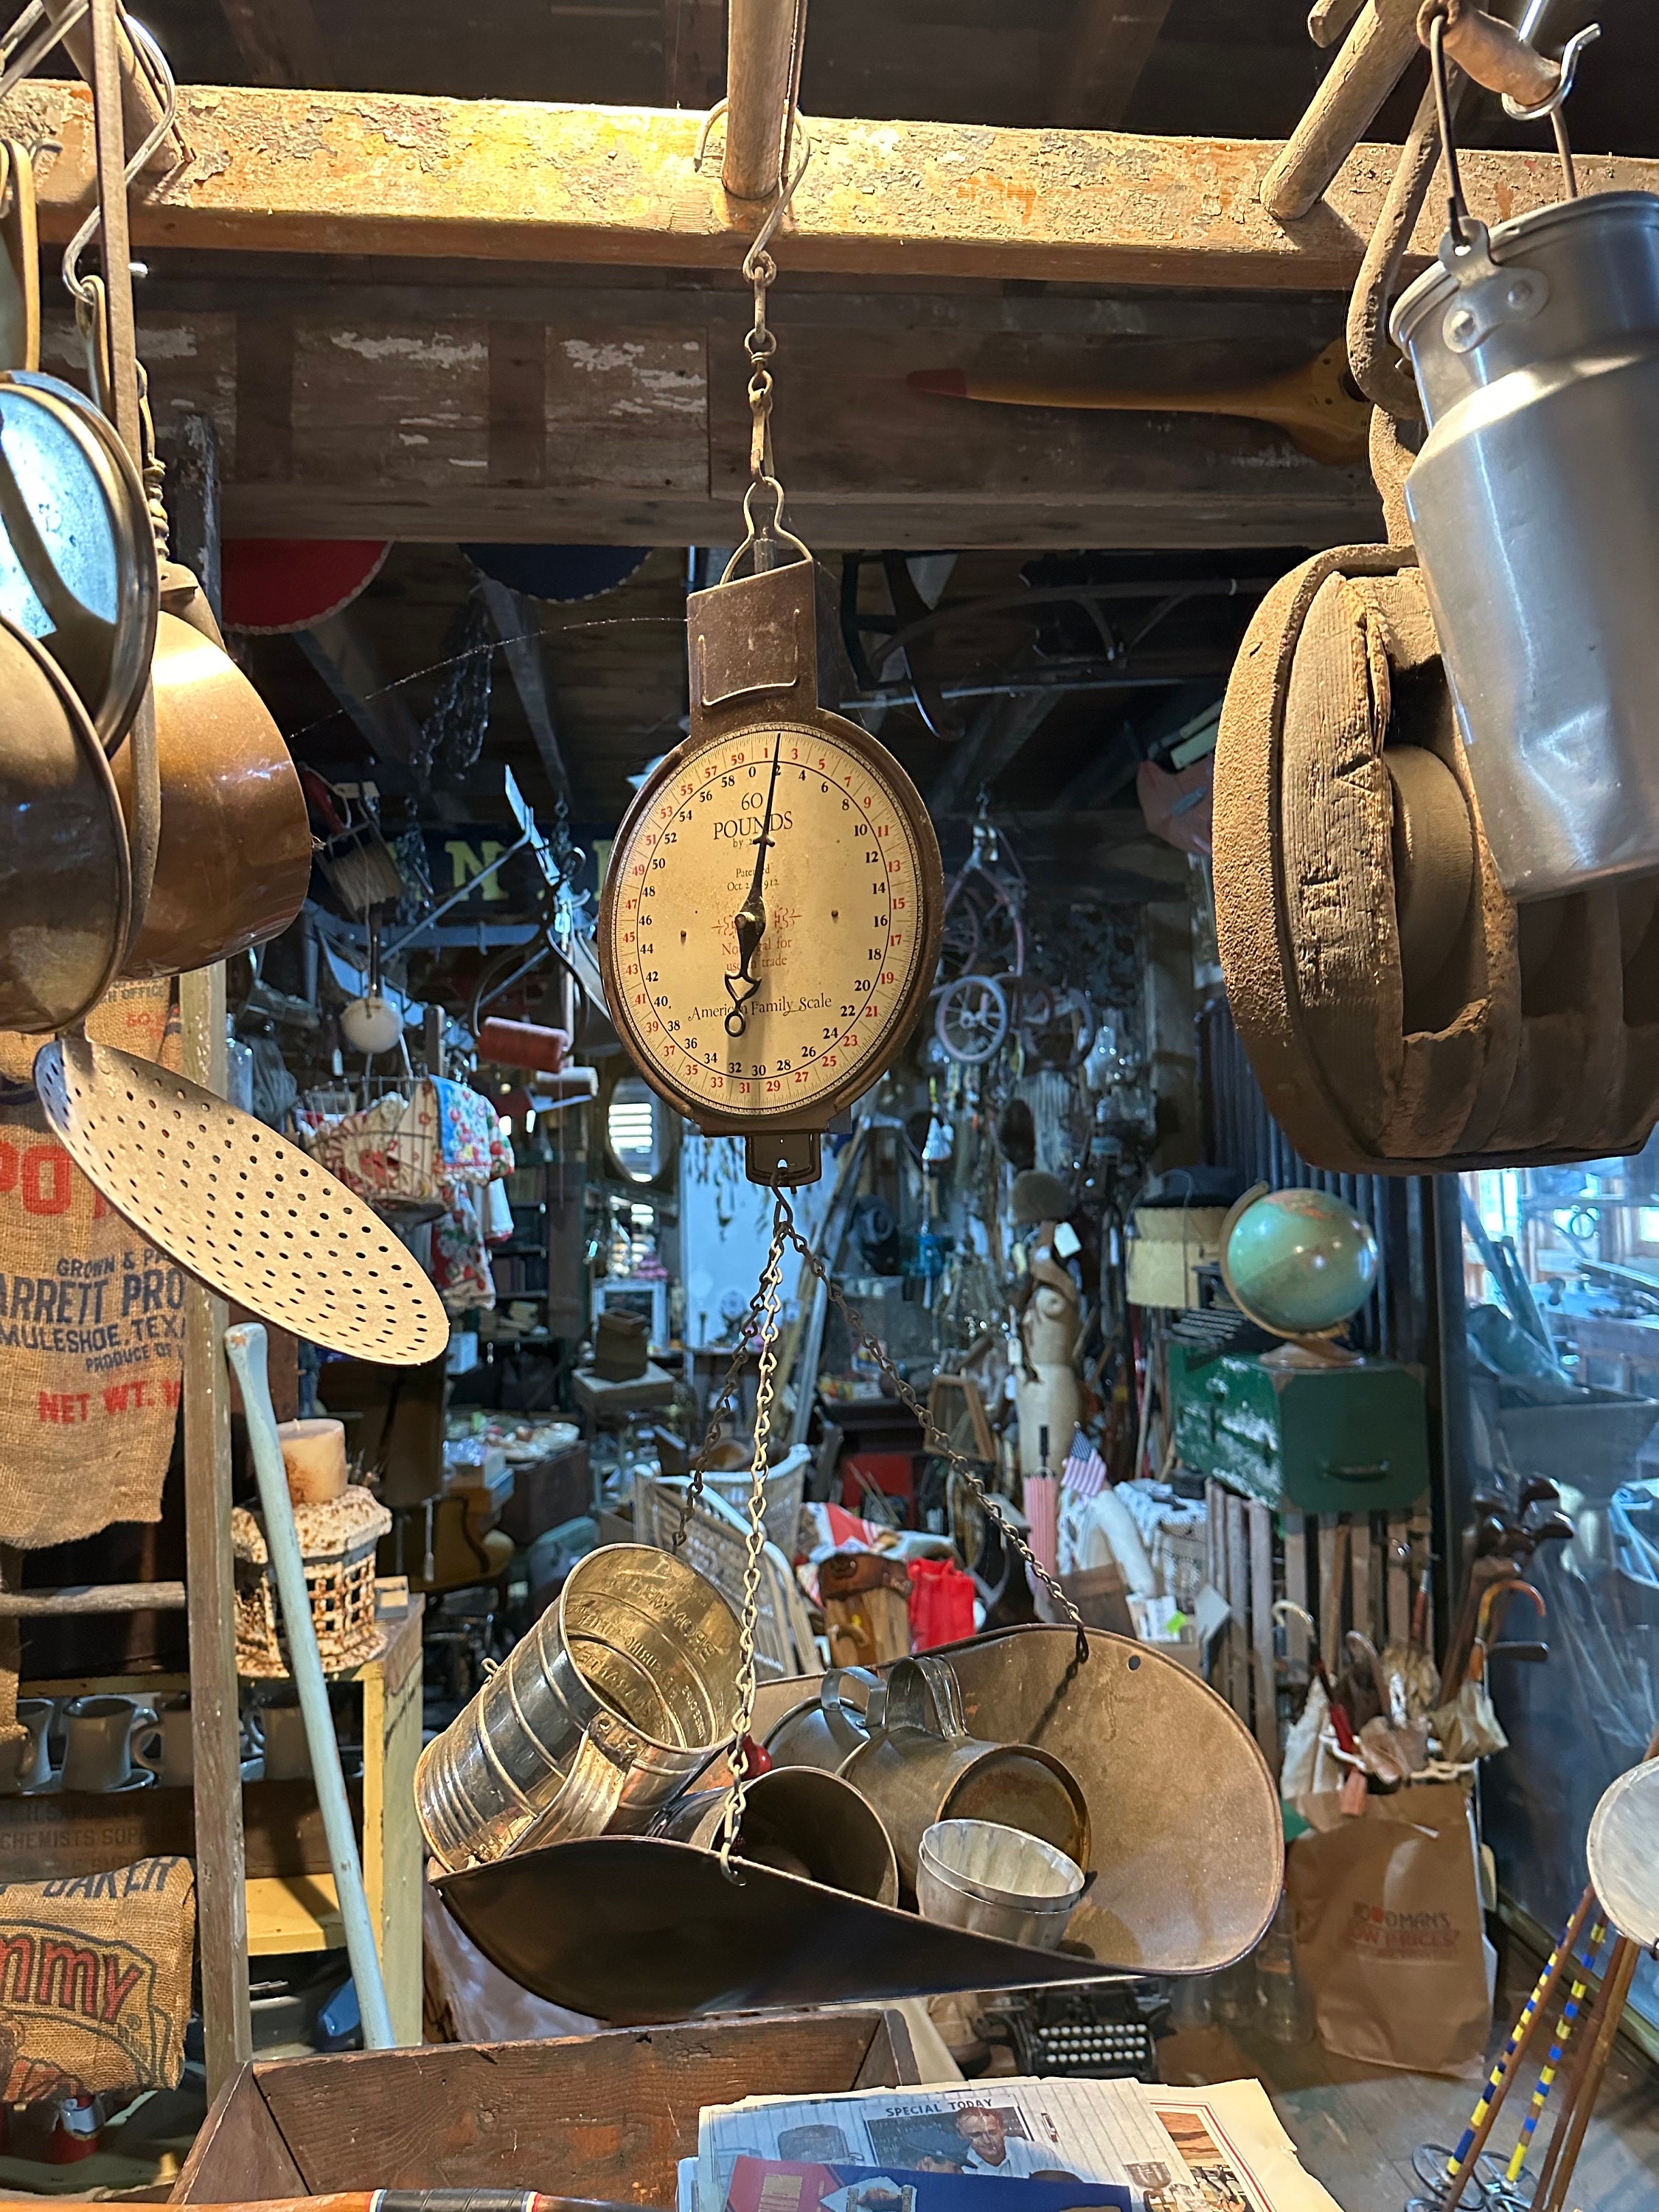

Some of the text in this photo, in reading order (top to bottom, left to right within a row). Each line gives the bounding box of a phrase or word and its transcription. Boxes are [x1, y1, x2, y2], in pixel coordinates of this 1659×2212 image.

[731, 752, 745, 765] 59
[764, 748, 768, 758] 1
[790, 748, 799, 759] 3
[818, 758, 826, 771] 5
[705, 765, 718, 779] 57
[748, 766, 757, 778] 0
[799, 770, 806, 782] 4
[721, 775, 735, 787] 58
[844, 776, 851, 787] 7
[680, 783, 693, 796] 55
[821, 782, 829, 793] 6
[700, 790, 712, 802] 56
[742, 792, 763, 810] 60
[863, 796, 872, 808] 9
[842, 799, 849, 811] 8
[661, 805, 672, 818] 53
[679, 810, 692, 822] 54
[714, 811, 793, 841] POUNDS
[854, 824, 868, 837] 10
[877, 824, 889, 838] 11
[646, 834, 656, 846] 51
[664, 832, 677, 844] 52
[866, 851, 879, 863] 12
[632, 864, 644, 876] 49
[652, 858, 666, 870] 50
[888, 860, 901, 873] 13
[736, 864, 770, 878] Pated
[727, 882, 742, 891] Oct
[762, 879, 779, 890] 912
[872, 882, 886, 895] 14
[642, 886, 655, 897] 48
[625, 899, 637, 910] 47
[892, 897, 905, 910] 15
[639, 914, 652, 926] 46
[874, 914, 888, 928] 16
[622, 932, 636, 943] 45
[890, 934, 902, 947] 17
[640, 944, 653, 954] 44
[722, 942, 740, 956] No
[776, 936, 792, 950] for
[869, 948, 882, 960] 18
[762, 954, 787, 967] trade
[625, 964, 639, 975] 43
[646, 971, 659, 982] 42
[880, 972, 894, 985] 19
[854, 979, 870, 992] 20
[635, 994, 646, 1004] 41
[653, 995, 668, 1007] 40
[688, 992, 832, 1022] Americn Family Scale
[841, 1004, 855, 1017] 22
[865, 1006, 878, 1018] 21
[646, 1020, 659, 1033] 39
[667, 1020, 681, 1032] 38
[823, 1027, 838, 1040] 24
[684, 1038, 698, 1049] 36
[843, 1034, 858, 1047] 23
[664, 1046, 675, 1057] 37
[801, 1046, 815, 1057] 26
[703, 1053, 717, 1064] 34
[821, 1056, 836, 1067] 25
[686, 1065, 698, 1075] 35
[728, 1062, 742, 1074] 32
[751, 1065, 766, 1077] 30
[776, 1059, 791, 1071] 28
[711, 1077, 723, 1088] 33
[795, 1071, 809, 1082] 27
[739, 1082, 751, 1093] 31
[766, 1079, 780, 1091] 29
[56, 1255, 115, 1278] GROWN
[39, 1389, 91, 1424] NET
[886, 2098, 992, 2118] SPECIAL TODAY
